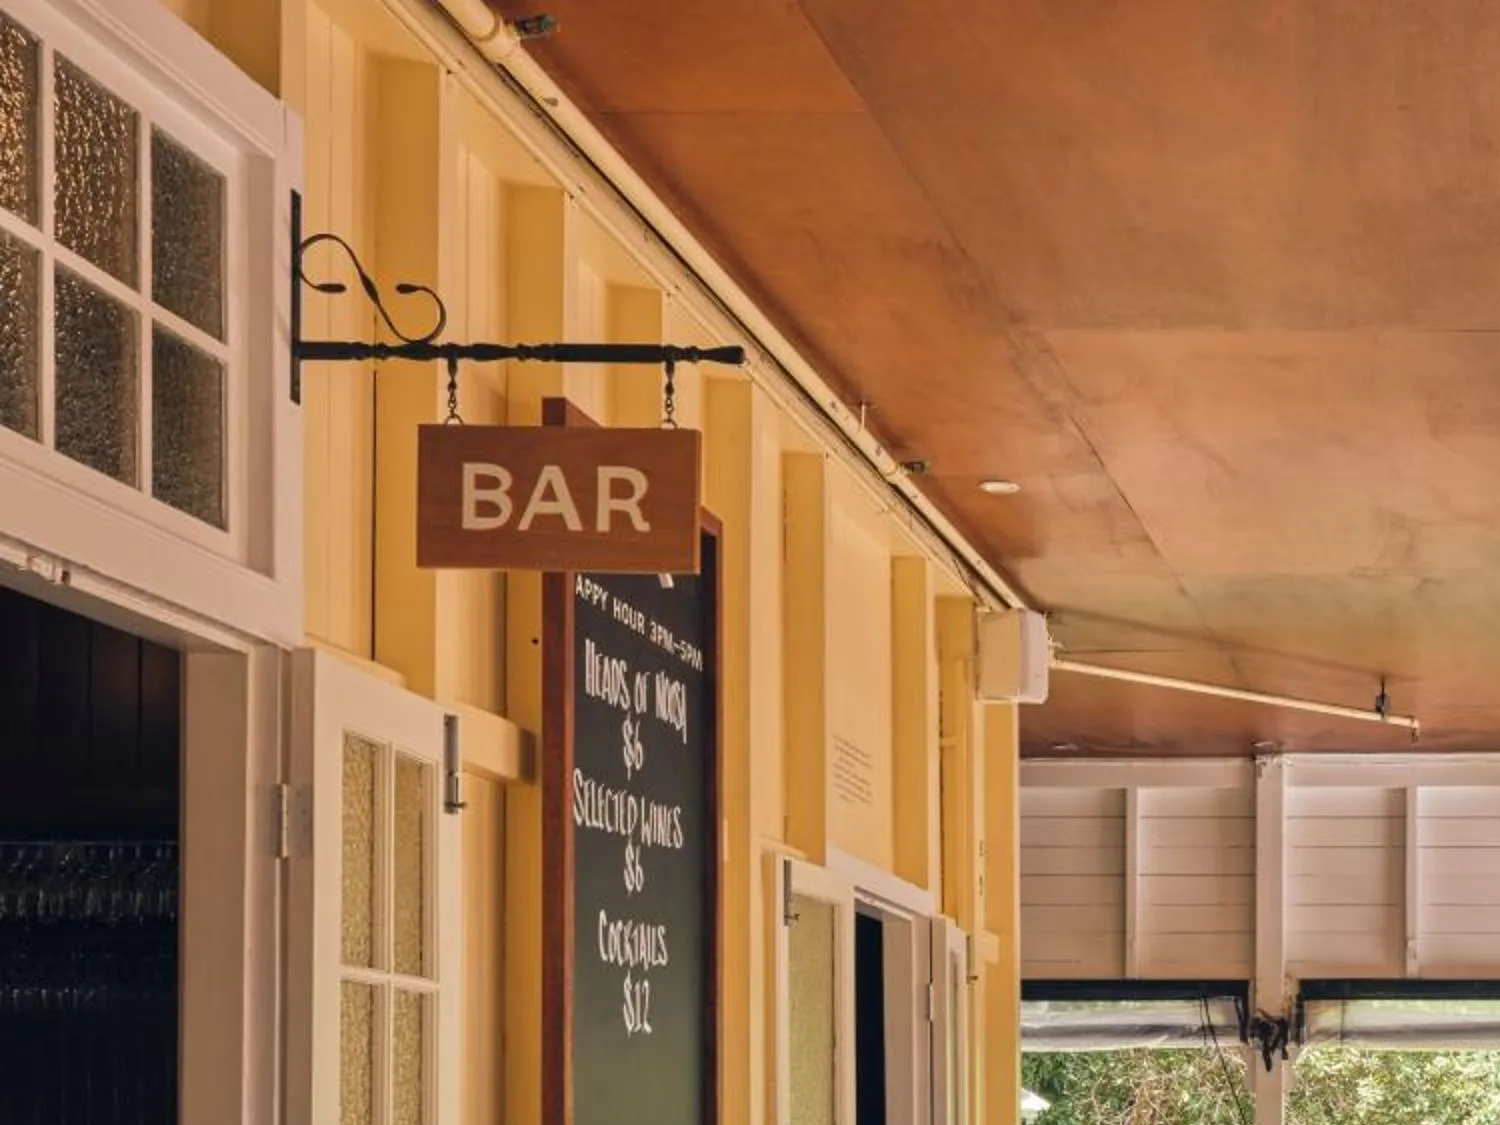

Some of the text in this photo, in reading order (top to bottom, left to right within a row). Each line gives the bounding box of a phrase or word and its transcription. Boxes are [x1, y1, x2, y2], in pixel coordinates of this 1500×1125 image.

[462, 463, 650, 532] BAR
[575, 573, 609, 611] APPY
[613, 597, 645, 635] HOUR
[585, 638, 630, 710] HEADS
[635, 672, 650, 714] OF
[622, 711, 643, 780] $6
[574, 767, 684, 849] SELECTED WINES
[624, 837, 644, 896] $6
[599, 909, 669, 971] COCKTAILS
[623, 970, 653, 1038] $12
